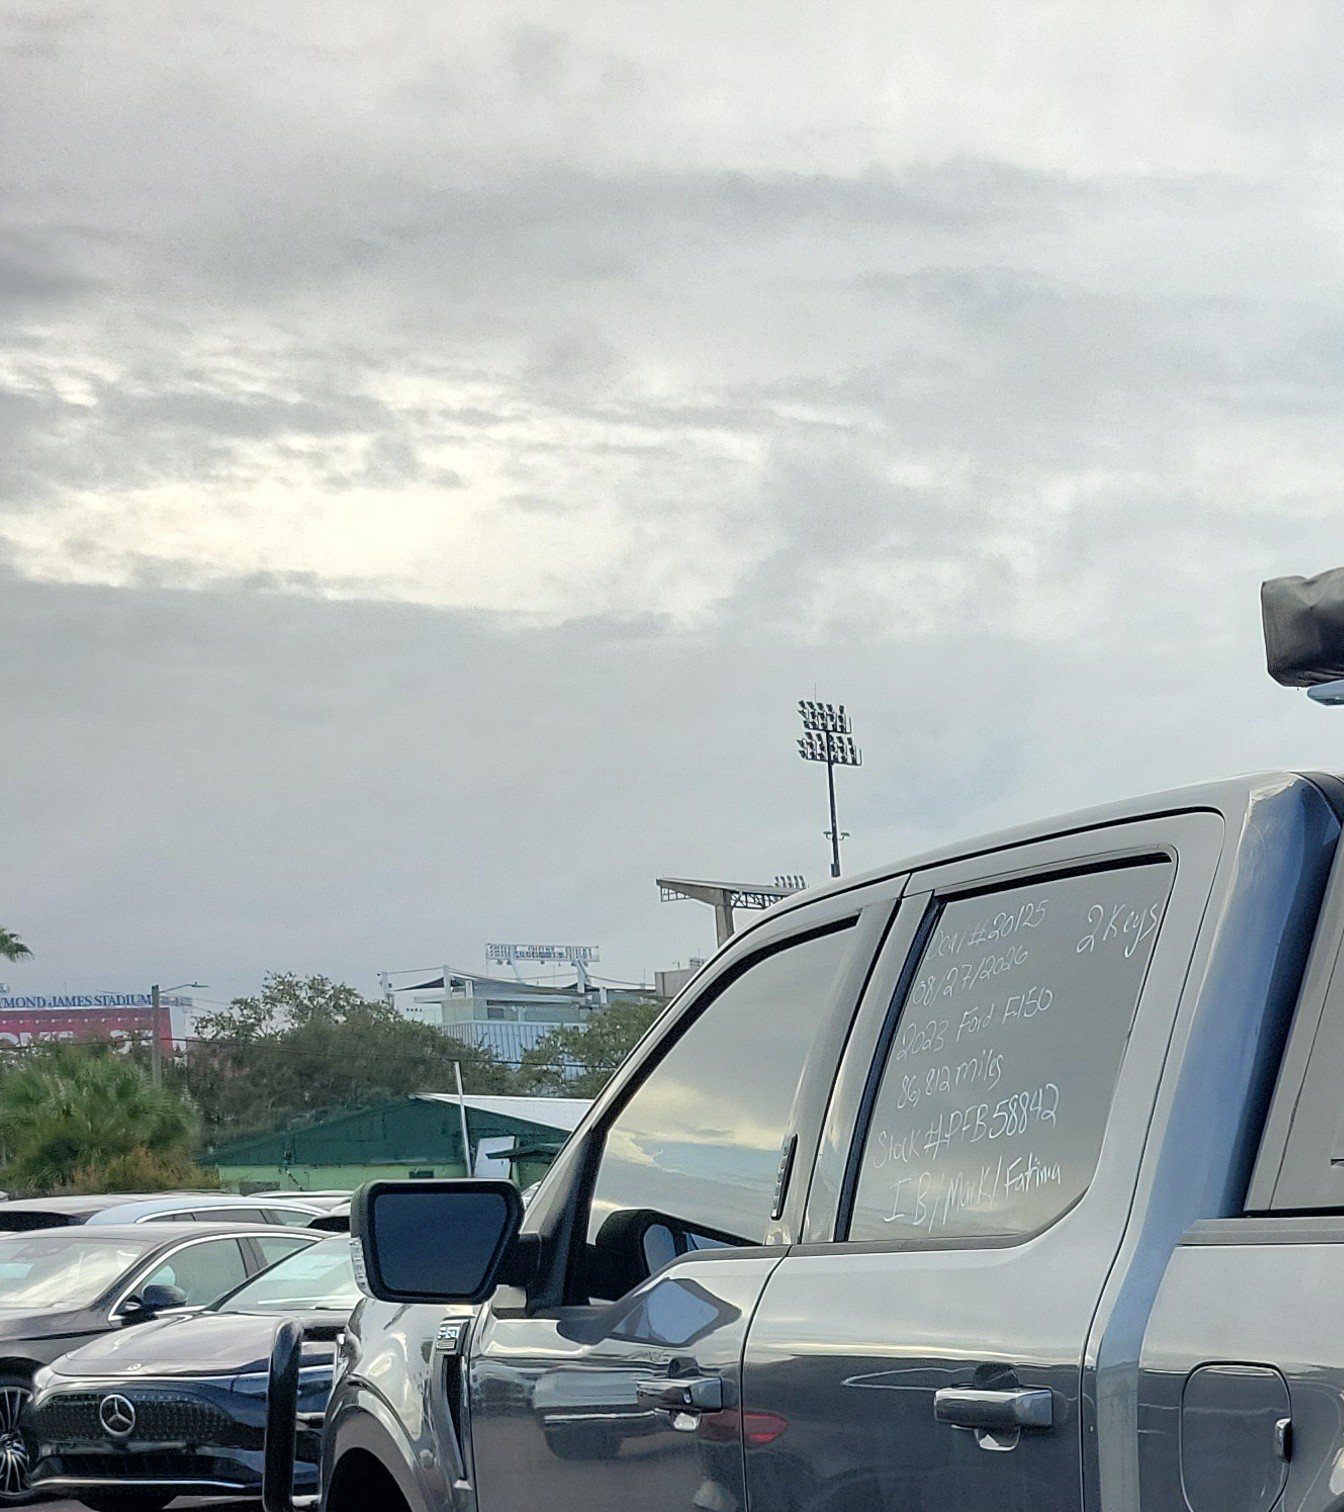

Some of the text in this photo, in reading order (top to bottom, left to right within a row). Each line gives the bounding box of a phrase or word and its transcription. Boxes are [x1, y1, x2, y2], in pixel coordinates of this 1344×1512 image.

[0, 996, 46, 1008] MOND
[49, 995, 92, 1007] JAMES
[95, 993, 152, 1006] STADIUM
[897, 1020, 948, 1060] 2023
[956, 1003, 995, 1042] Ford
[955, 1048, 1004, 1092] miles
